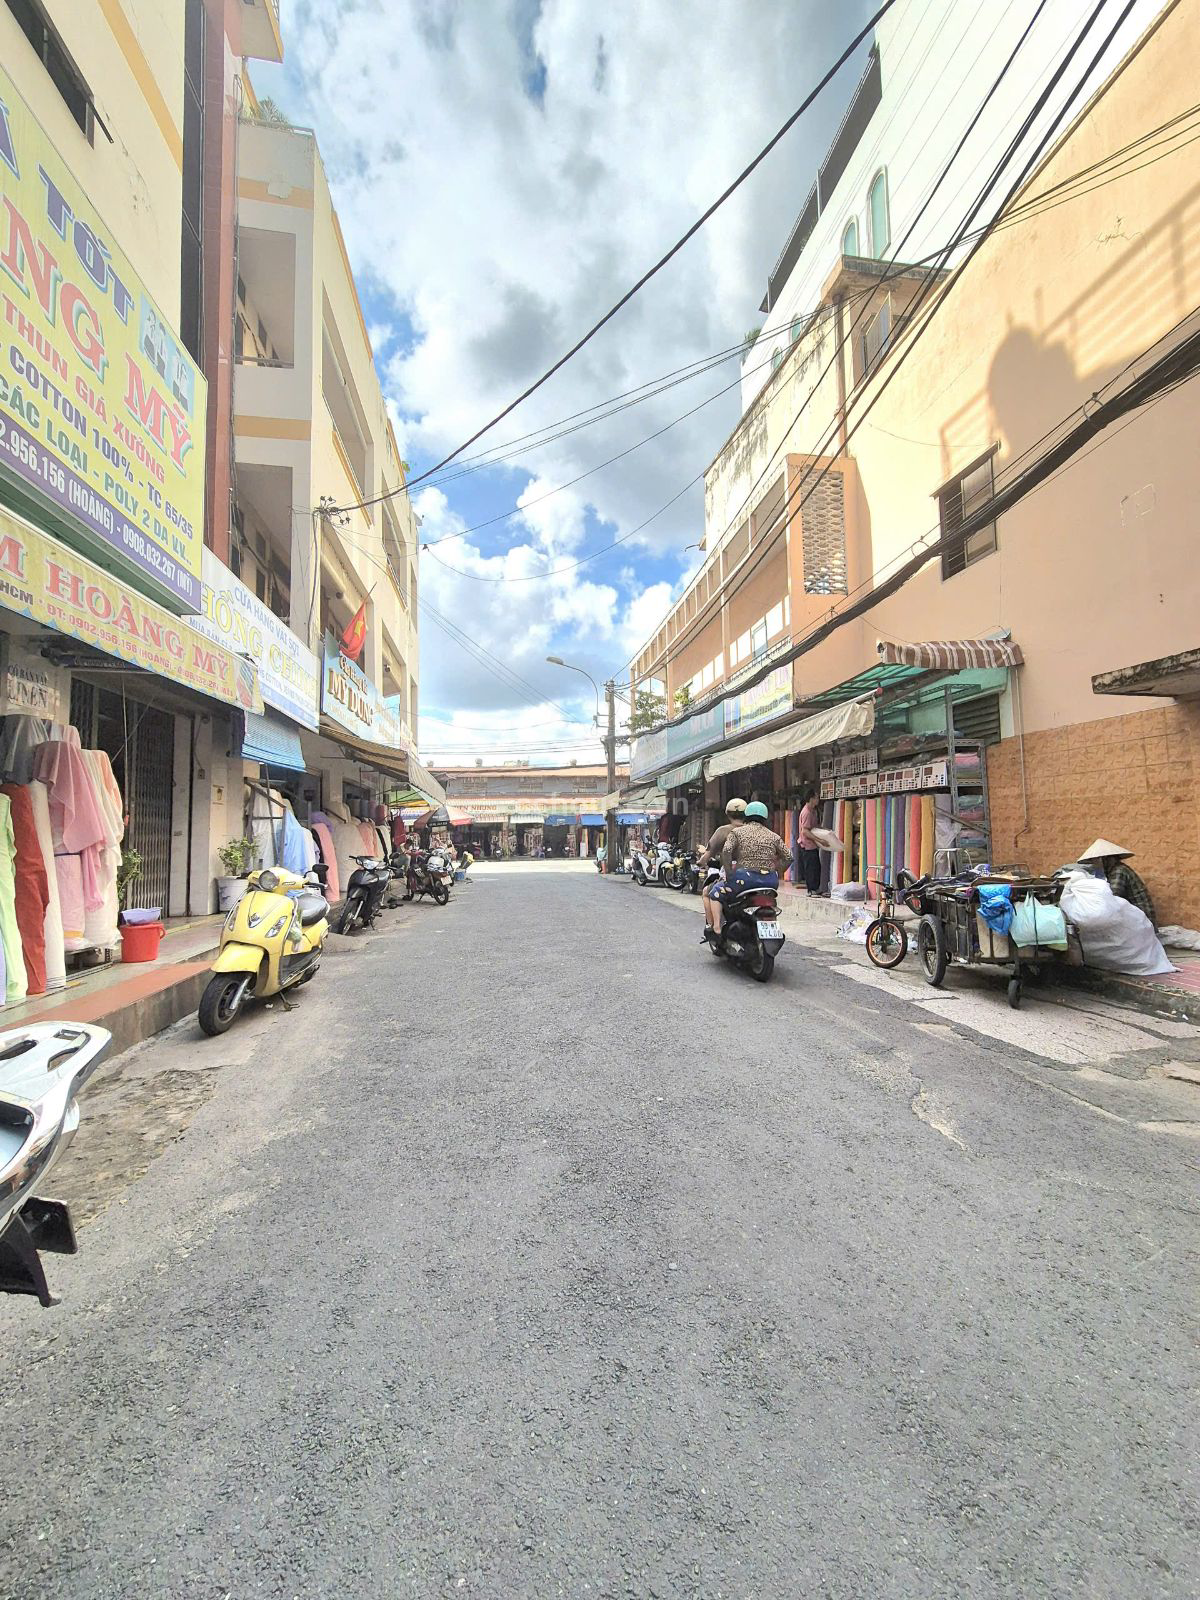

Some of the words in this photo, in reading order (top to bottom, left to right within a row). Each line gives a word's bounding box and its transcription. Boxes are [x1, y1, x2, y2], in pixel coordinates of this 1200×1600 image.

[2, 294, 69, 383] THUN
[10, 344, 87, 438] COTTON
[92, 427, 134, 484] 100%
[147, 481, 162, 509] TC
[165, 500, 194, 541] 65/35
[124, 351, 194, 479] MỸ
[46, 418, 88, 475] LOẠI
[104, 475, 139, 518] POLY
[142, 509, 150, 529] 2
[153, 516, 169, 543] DA
[68, 479, 115, 535] (HOÀNG)
[123, 524, 176, 582] 0908.032.267
[45, 558, 185, 662] HOÀNG
[192, 643, 229, 681] MỸ
